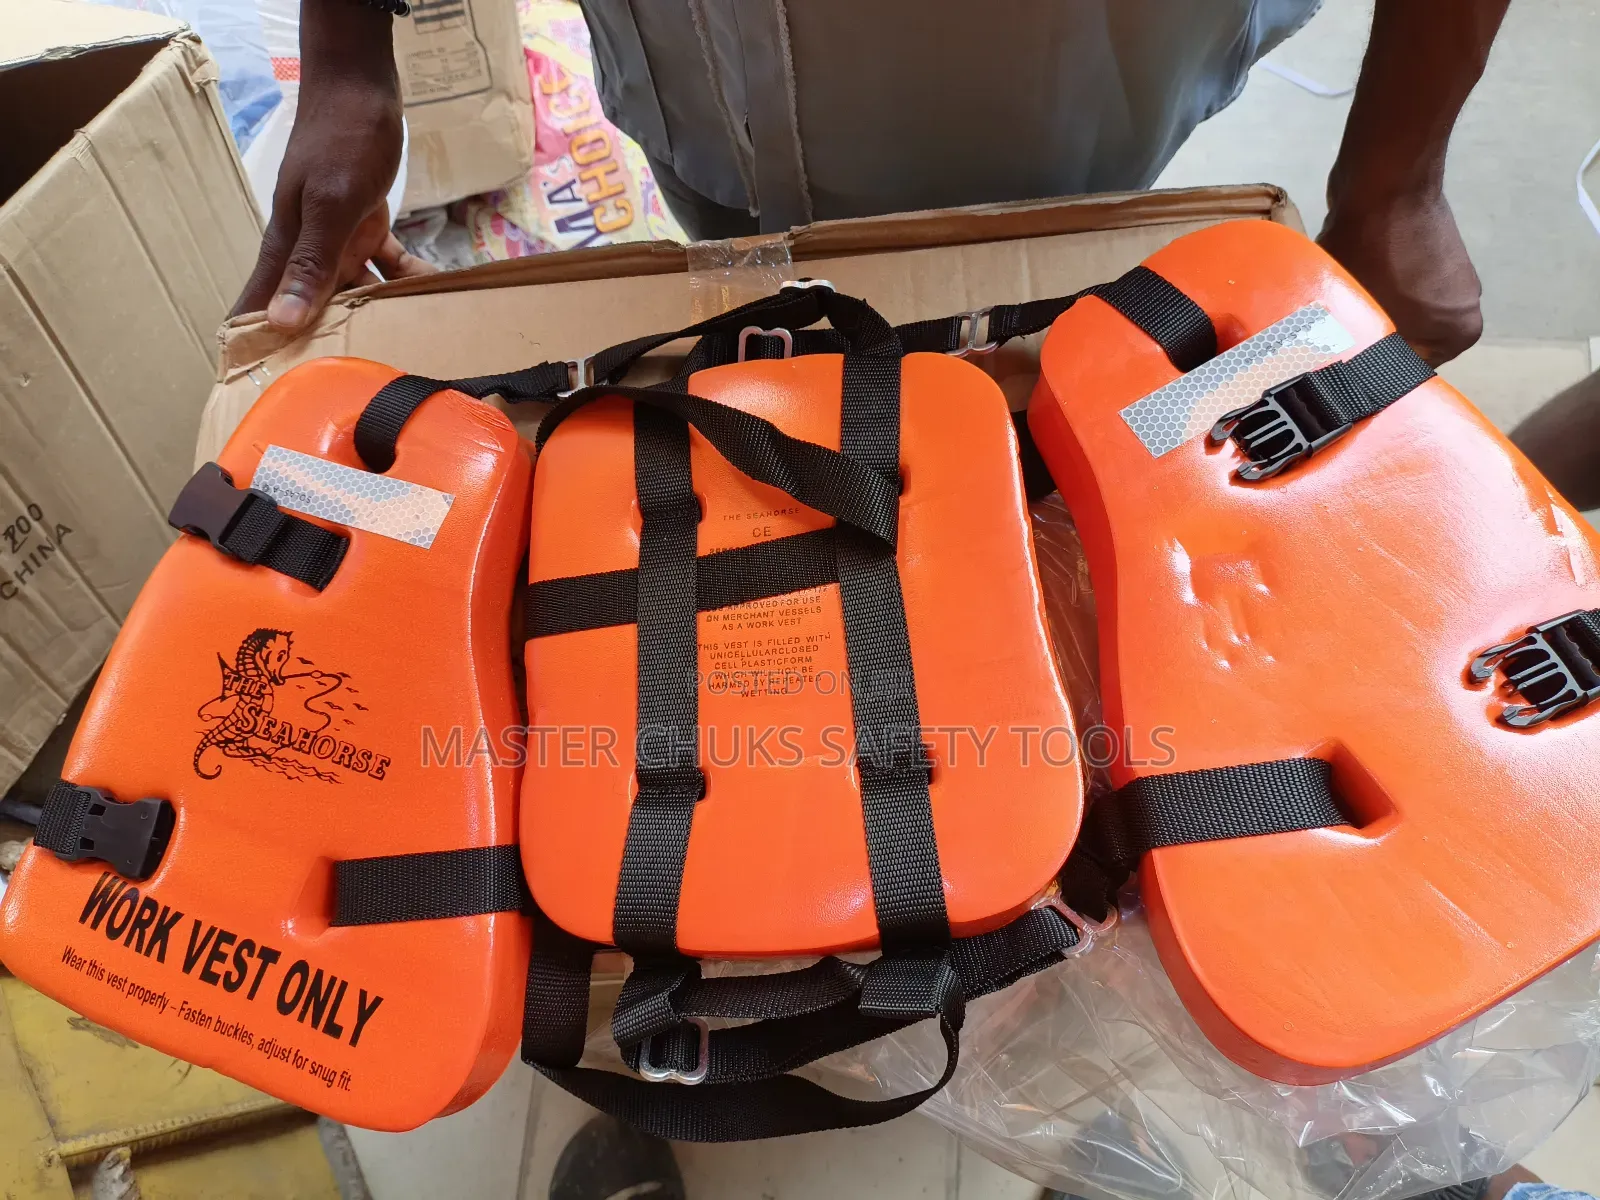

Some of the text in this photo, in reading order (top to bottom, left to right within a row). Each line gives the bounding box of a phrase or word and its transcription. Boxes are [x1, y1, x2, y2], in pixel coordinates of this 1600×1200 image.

[539, 66, 635, 234] CHOICE
[723, 507, 801, 521] THE SEAHORSE
[752, 526, 772, 538] CE
[0, 523, 73, 601] CHINA
[780, 598, 800, 607] FOR
[802, 595, 821, 604] USE
[706, 614, 720, 623] ON
[722, 609, 775, 622] MERCHANT
[778, 606, 822, 617] VESSELS
[721, 617, 802, 631] AS A WORK VEST
[698, 632, 831, 651] THIS VEST IS FILLED WITH
[714, 661, 737, 670] CELL
[714, 670, 749, 680] WHICH
[751, 669, 773, 679] WILL
[801, 665, 814, 673] BE
[223, 671, 268, 698] THE
[708, 674, 822, 690] HARMED BY REPEATED
[740, 687, 788, 698] WETTING
[236, 703, 392, 780] SEAHORSE
[78, 871, 384, 1048] WORK VEST ONLY
[61, 945, 87, 972] Wear
[87, 958, 105, 982] this
[106, 970, 129, 993] vest
[128, 976, 171, 1015] properly
[177, 1000, 213, 1030] Fasten
[213, 1012, 255, 1050] buckles,
[257, 1036, 292, 1064] adjust
[291, 1049, 309, 1071] for
[308, 1060, 338, 1089] snug
[337, 1066, 352, 1092] fit.
